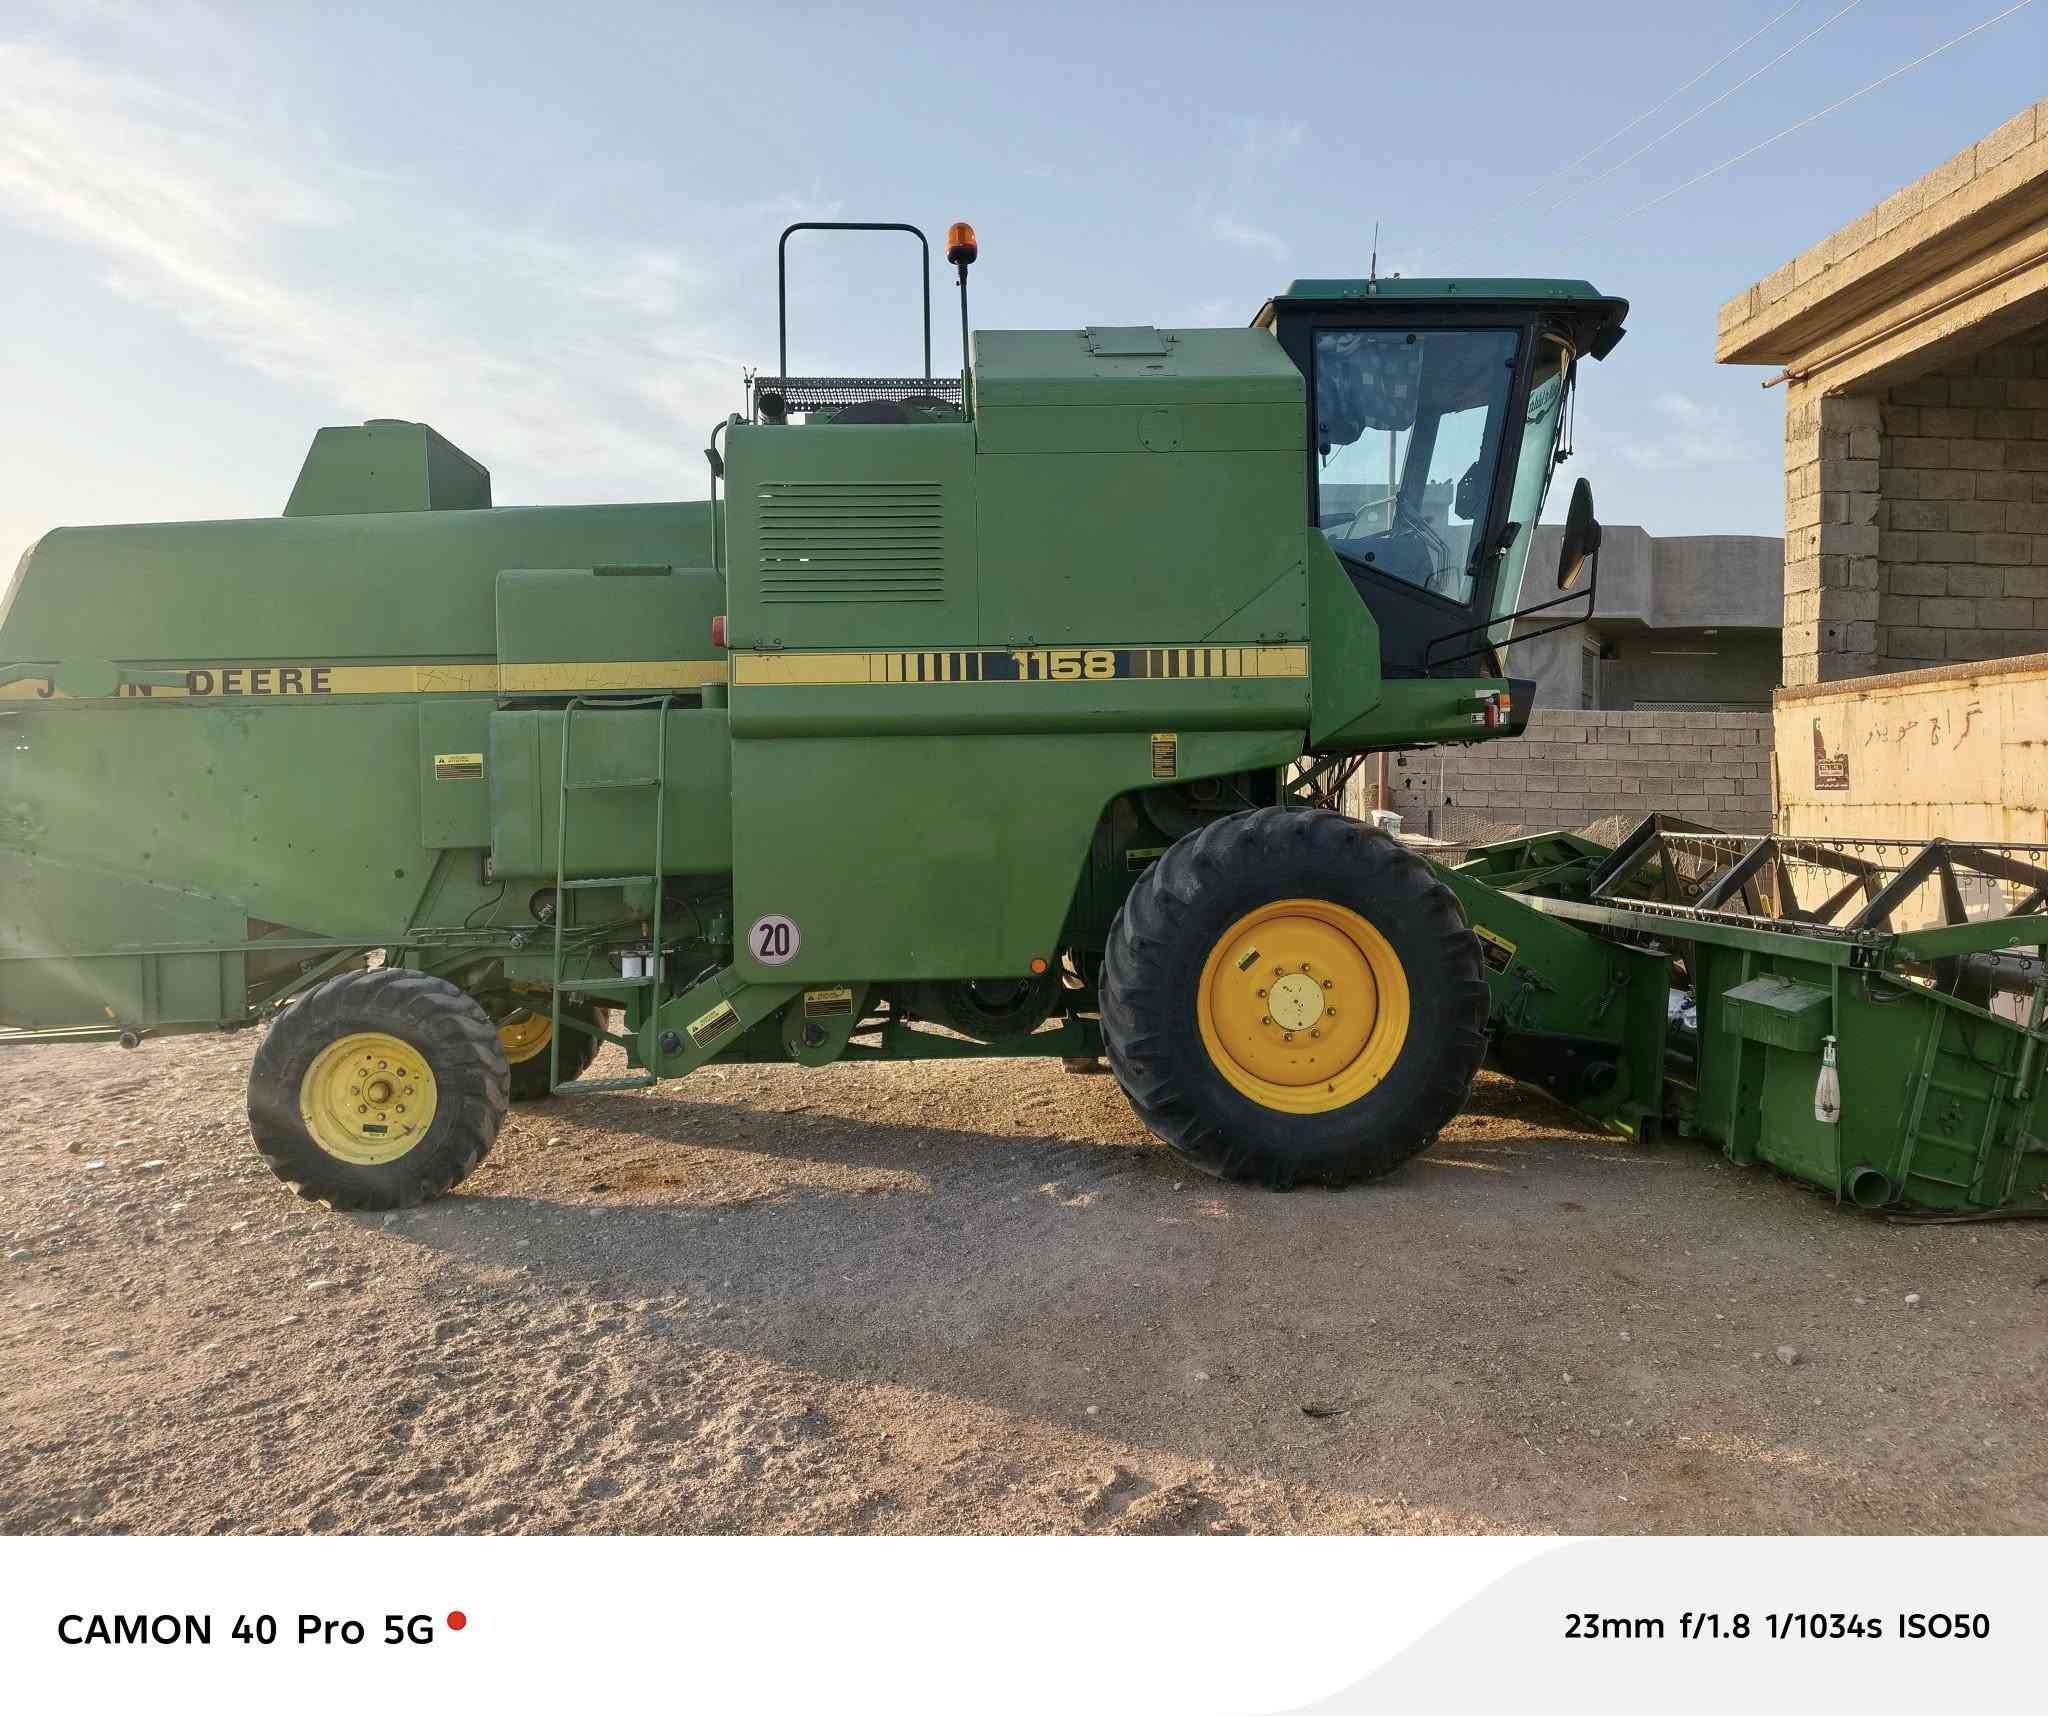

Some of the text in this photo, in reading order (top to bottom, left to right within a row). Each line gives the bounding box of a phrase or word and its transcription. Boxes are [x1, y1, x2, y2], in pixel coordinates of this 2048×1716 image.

[1011, 650, 1117, 680] 1158
[186, 668, 333, 696] DEERE
[759, 923, 790, 957] 20
